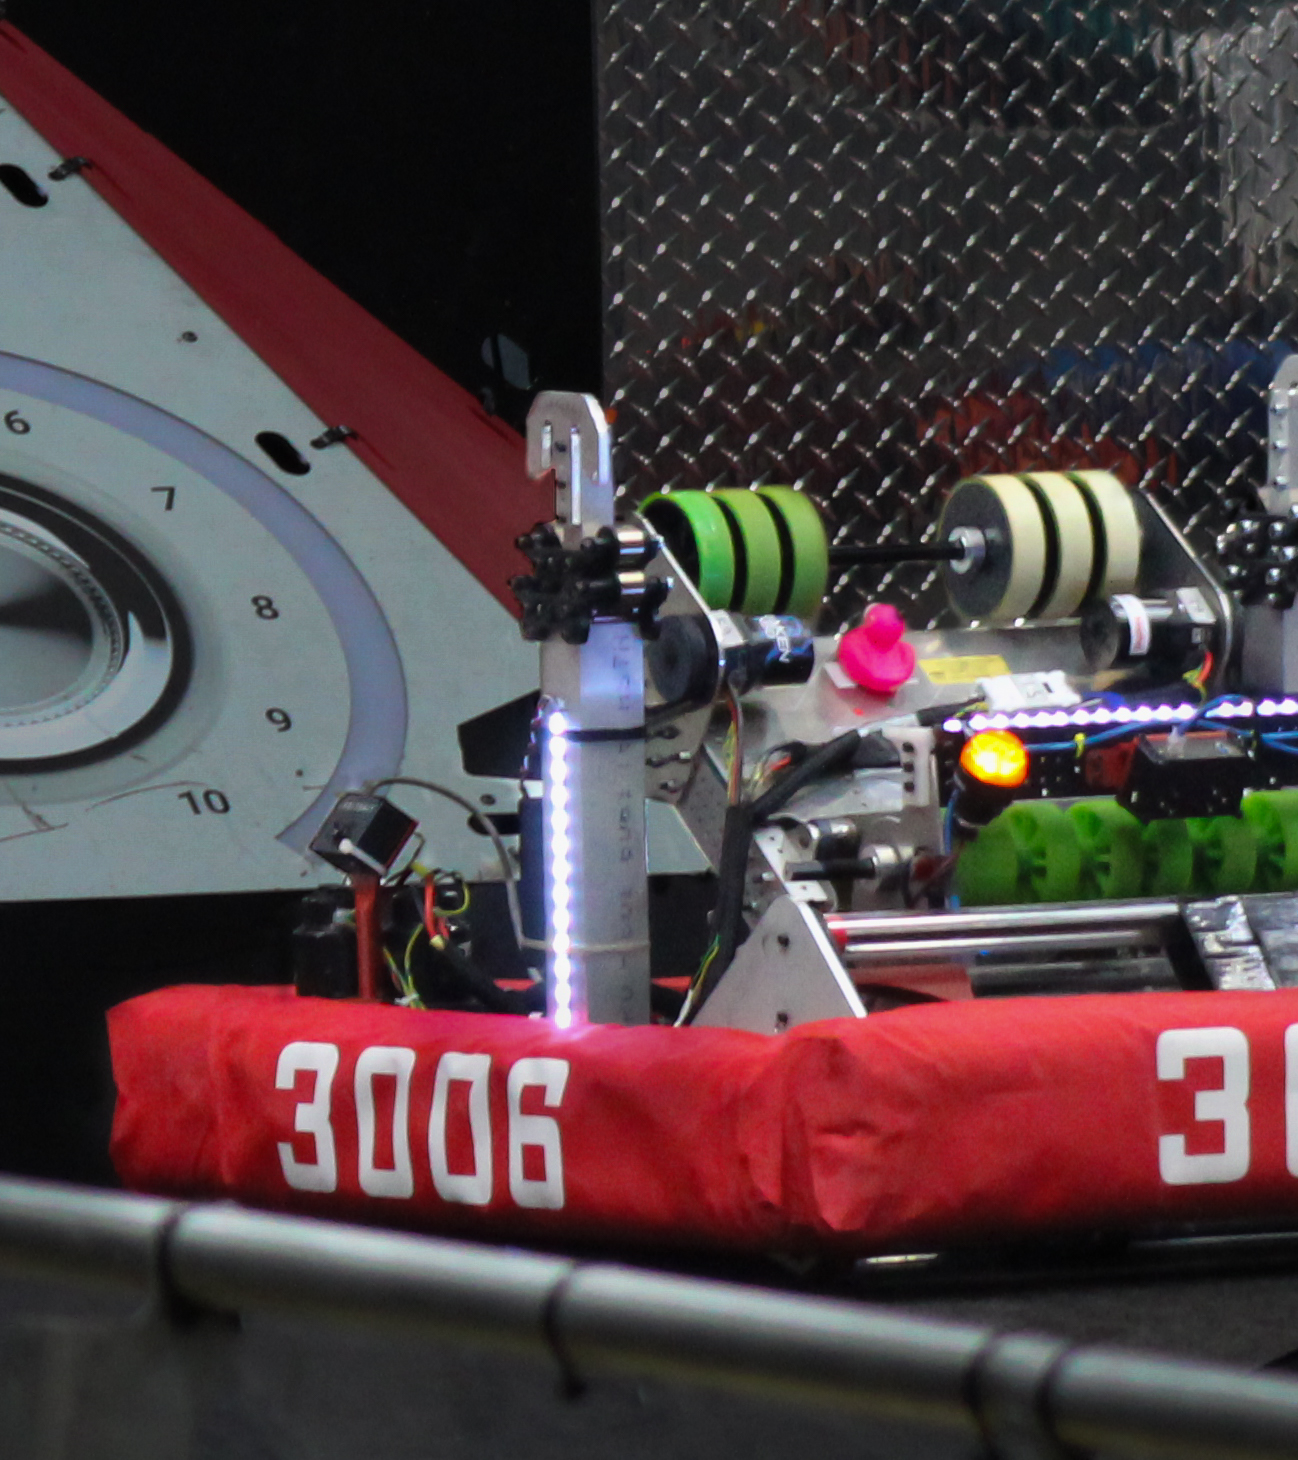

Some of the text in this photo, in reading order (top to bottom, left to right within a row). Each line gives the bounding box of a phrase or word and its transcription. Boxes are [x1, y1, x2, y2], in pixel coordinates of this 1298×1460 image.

[4, 410, 31, 435] 6
[150, 486, 175, 511] 7
[251, 595, 279, 620] 8
[265, 707, 292, 732] 9
[178, 789, 231, 815] 10
[275, 1041, 570, 1210] 3006
